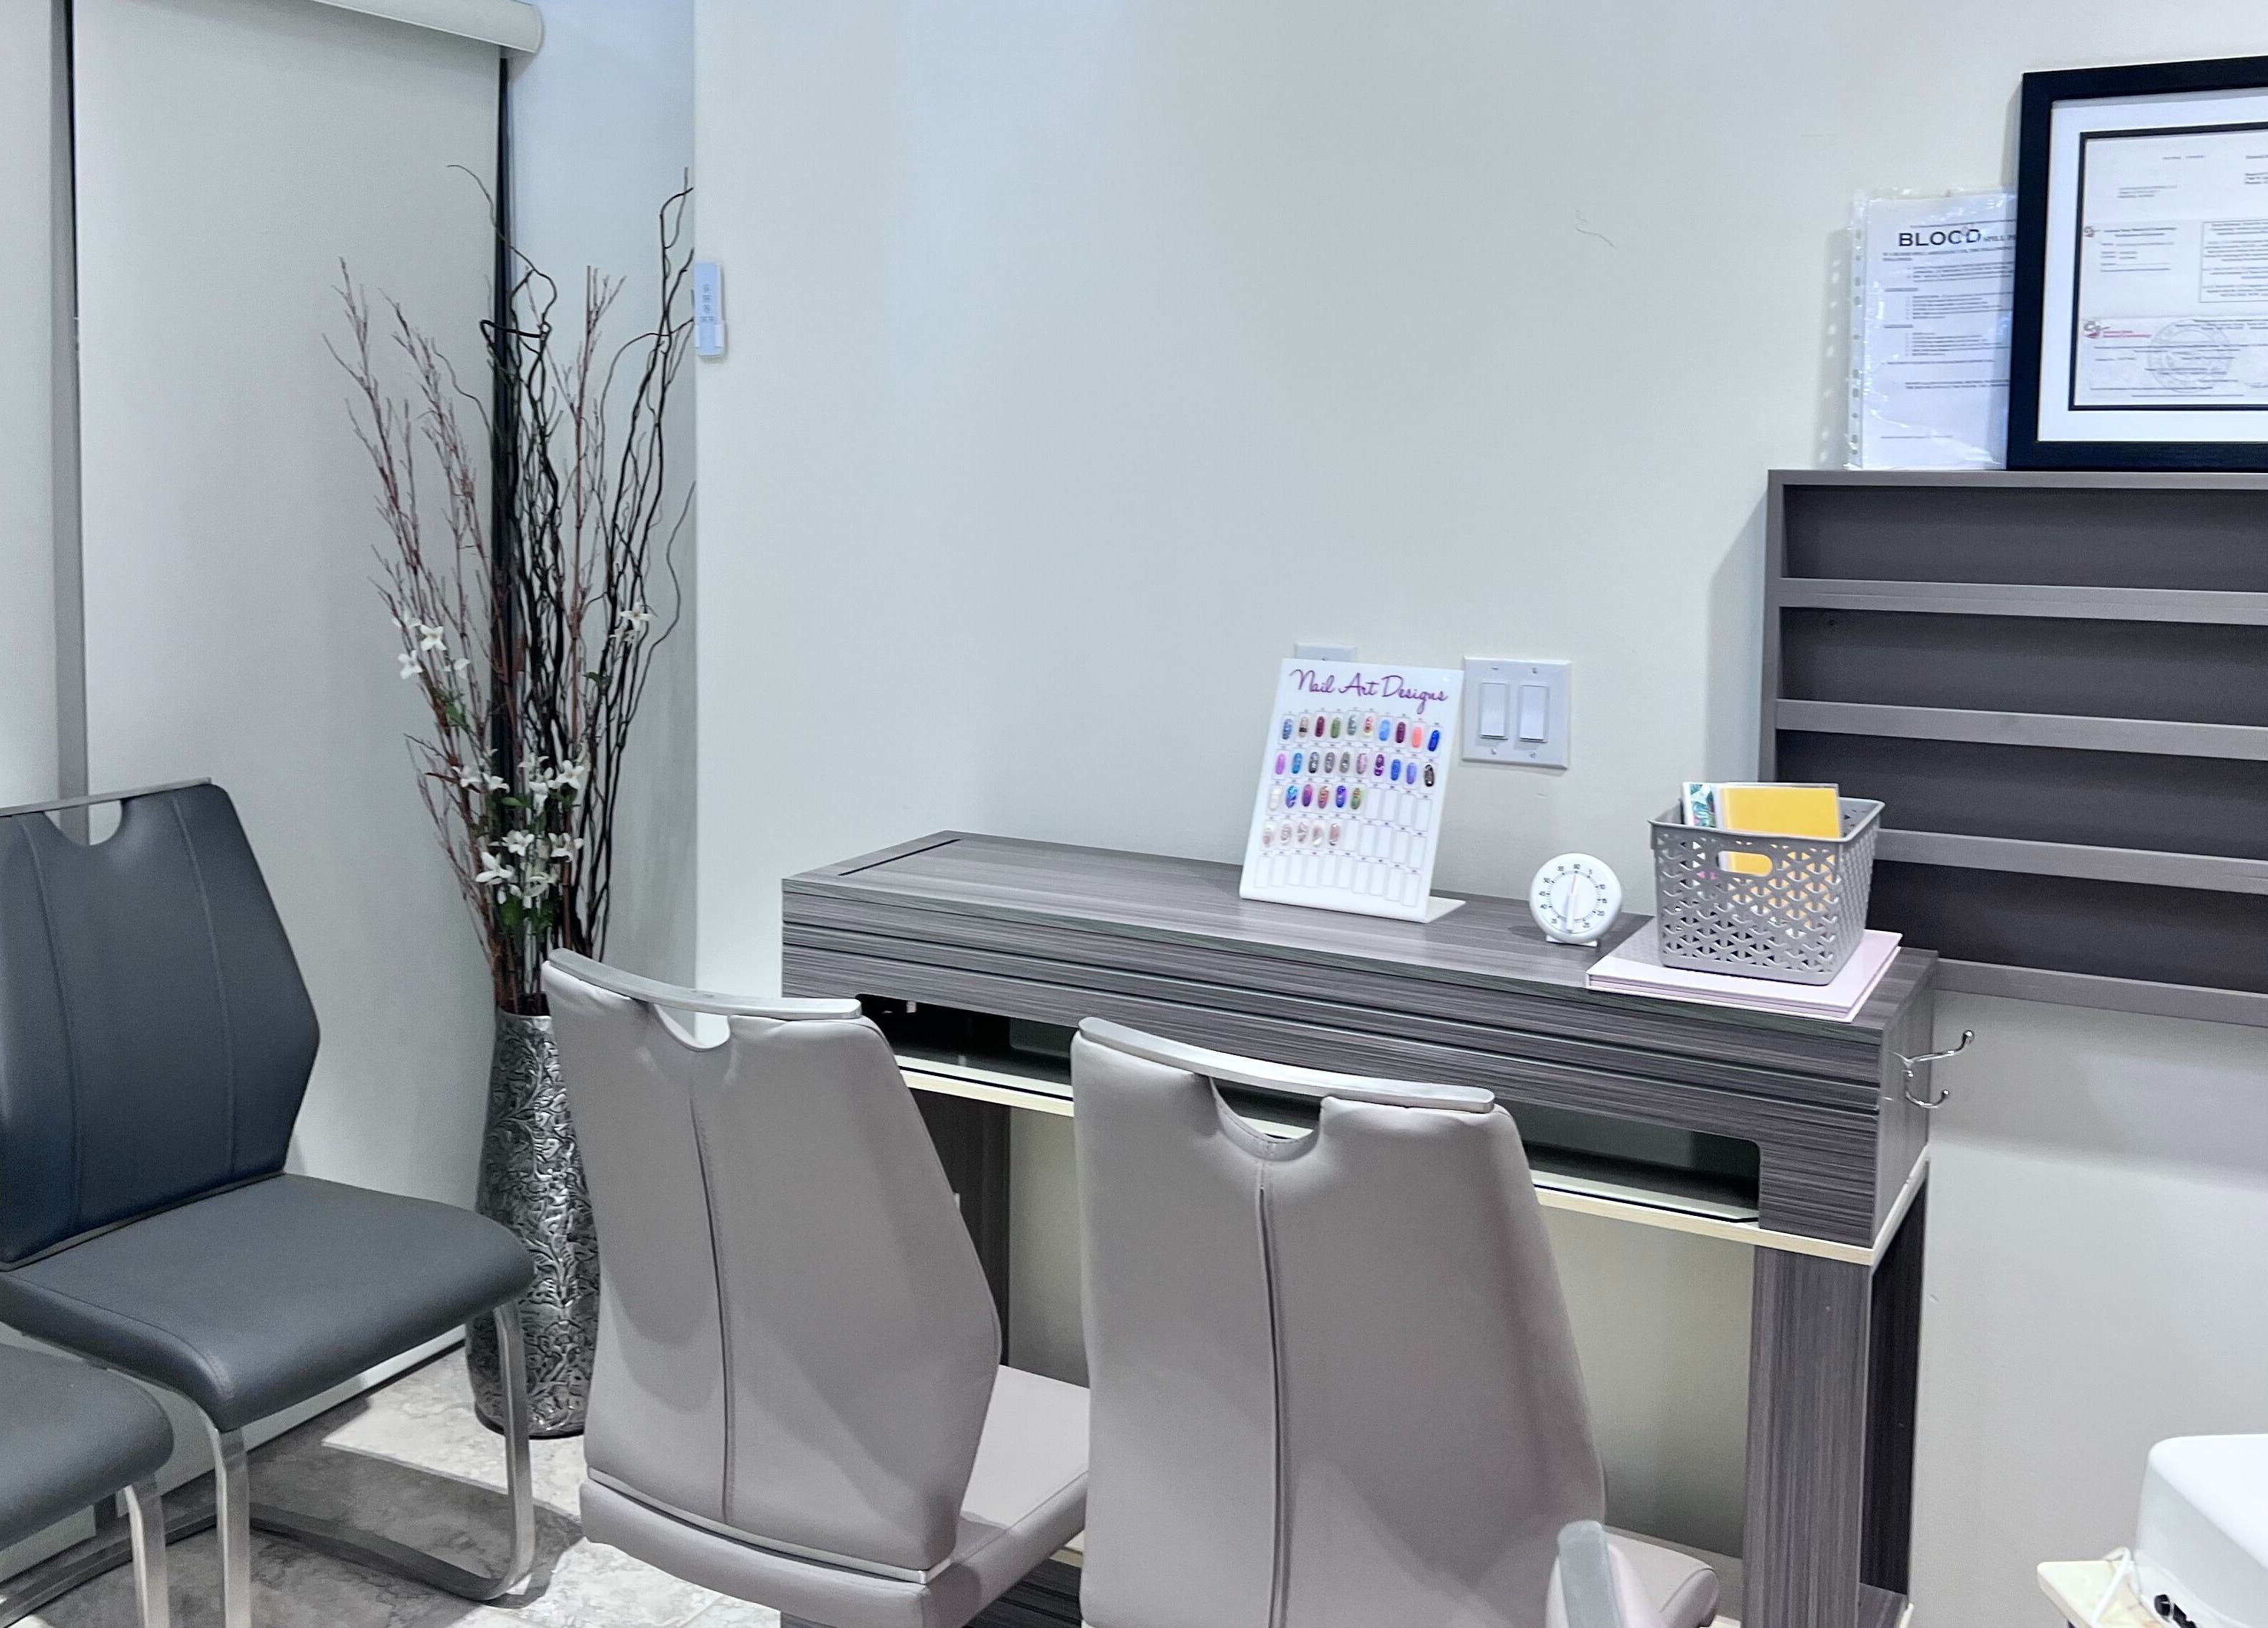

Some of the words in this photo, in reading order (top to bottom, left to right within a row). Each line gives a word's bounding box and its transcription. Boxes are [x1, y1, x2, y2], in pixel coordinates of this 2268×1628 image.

[1289, 668, 1335, 693] Nail
[1339, 672, 1379, 697] Art
[1382, 675, 1449, 715] Designs
